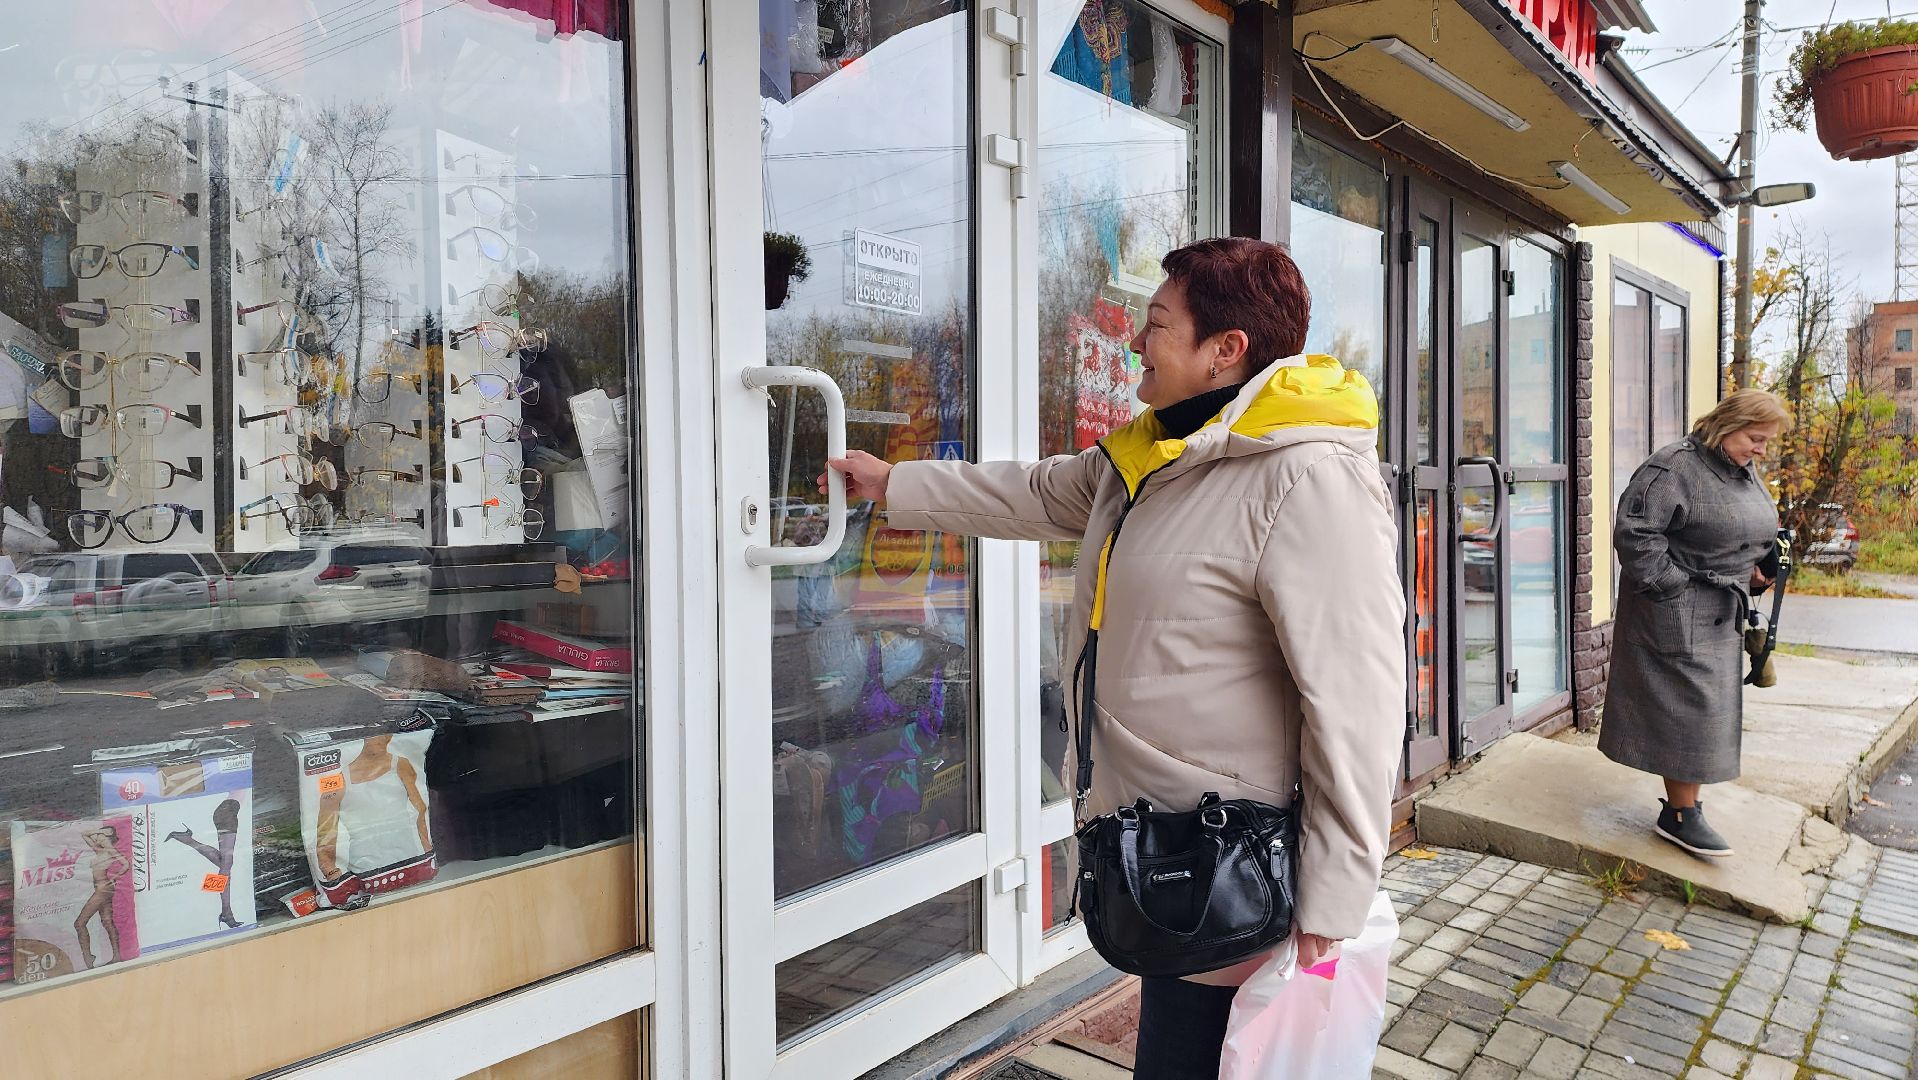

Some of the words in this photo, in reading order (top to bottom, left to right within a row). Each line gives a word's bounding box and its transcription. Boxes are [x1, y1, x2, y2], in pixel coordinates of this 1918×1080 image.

[860, 239, 918, 266] ОТКРЫТО
[864, 270, 914, 290] ЕЖЕДНЕВНО
[859, 285, 920, 309] 10:00-20:00
[558, 644, 589, 661] GIULIA
[124, 780, 140, 794] 40
[20, 865, 76, 890] Miss
[26, 952, 57, 974] 50
[18, 971, 47, 985] den
